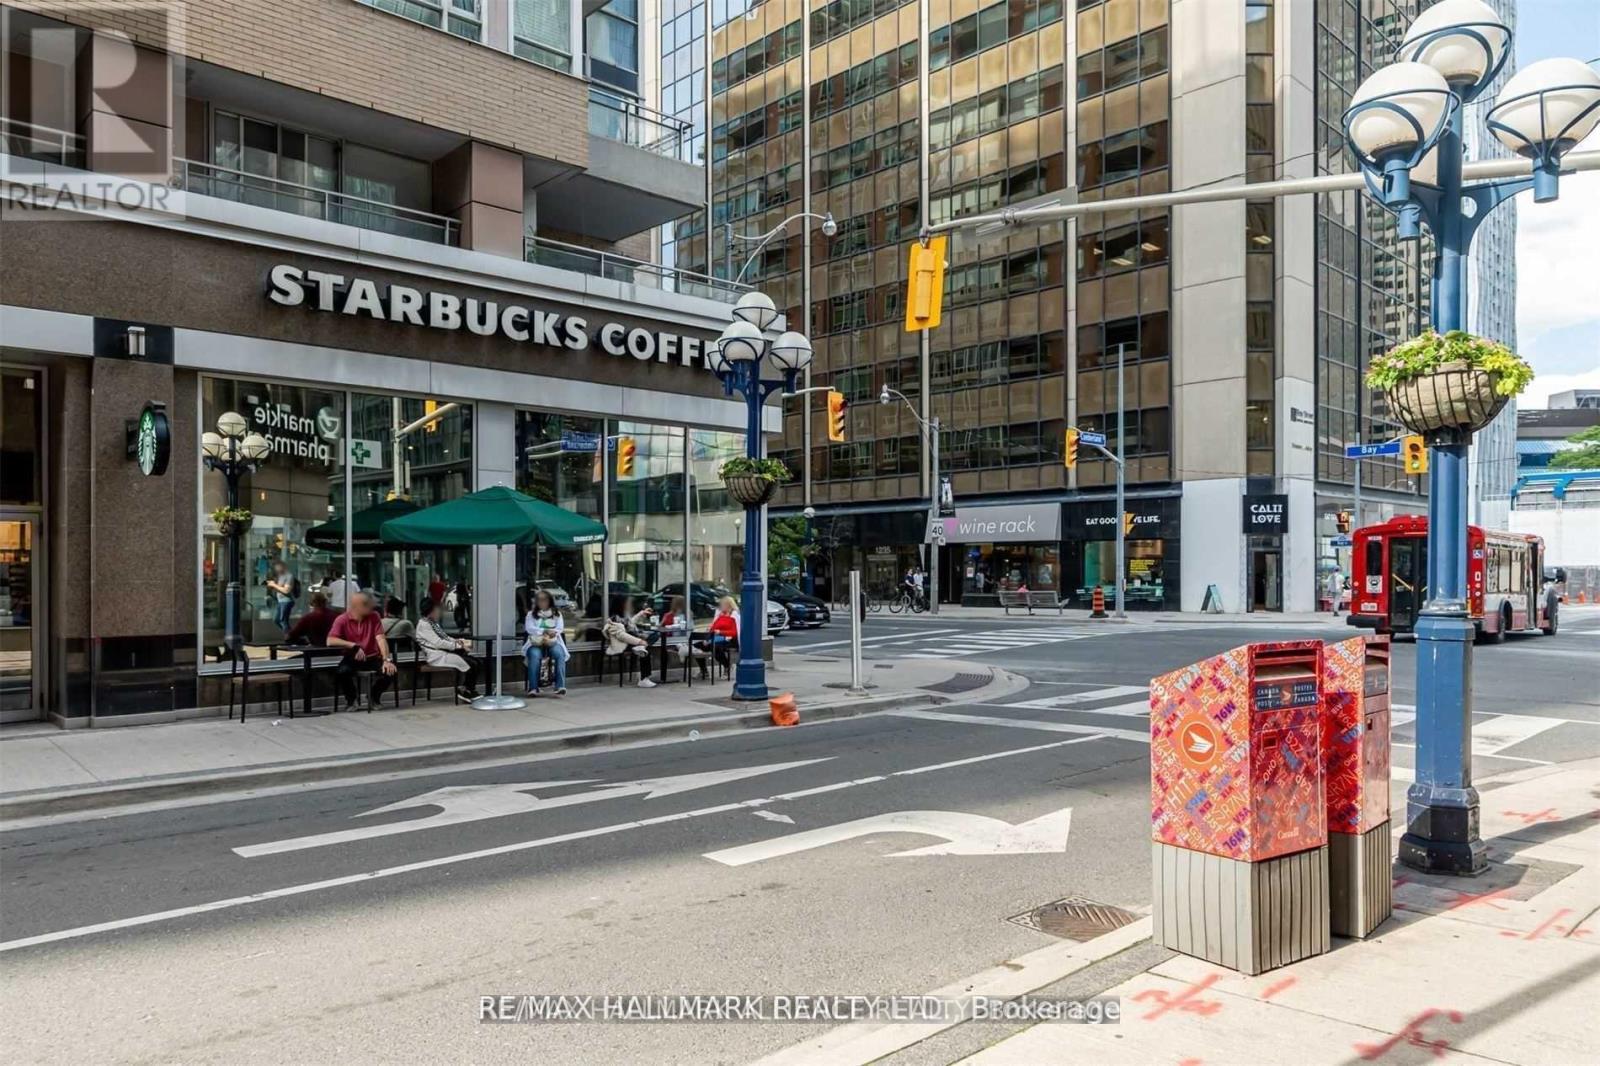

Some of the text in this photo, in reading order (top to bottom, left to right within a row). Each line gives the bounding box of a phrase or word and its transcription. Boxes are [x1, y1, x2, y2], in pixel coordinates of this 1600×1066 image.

[269, 263, 718, 370] STARBUCKS COFF
[1361, 446, 1377, 456] Bay
[959, 514, 1036, 534] wine rack
[1099, 517, 1117, 525] GOO
[1251, 514, 1281, 524] LOVE
[932, 526, 943, 535] 40
